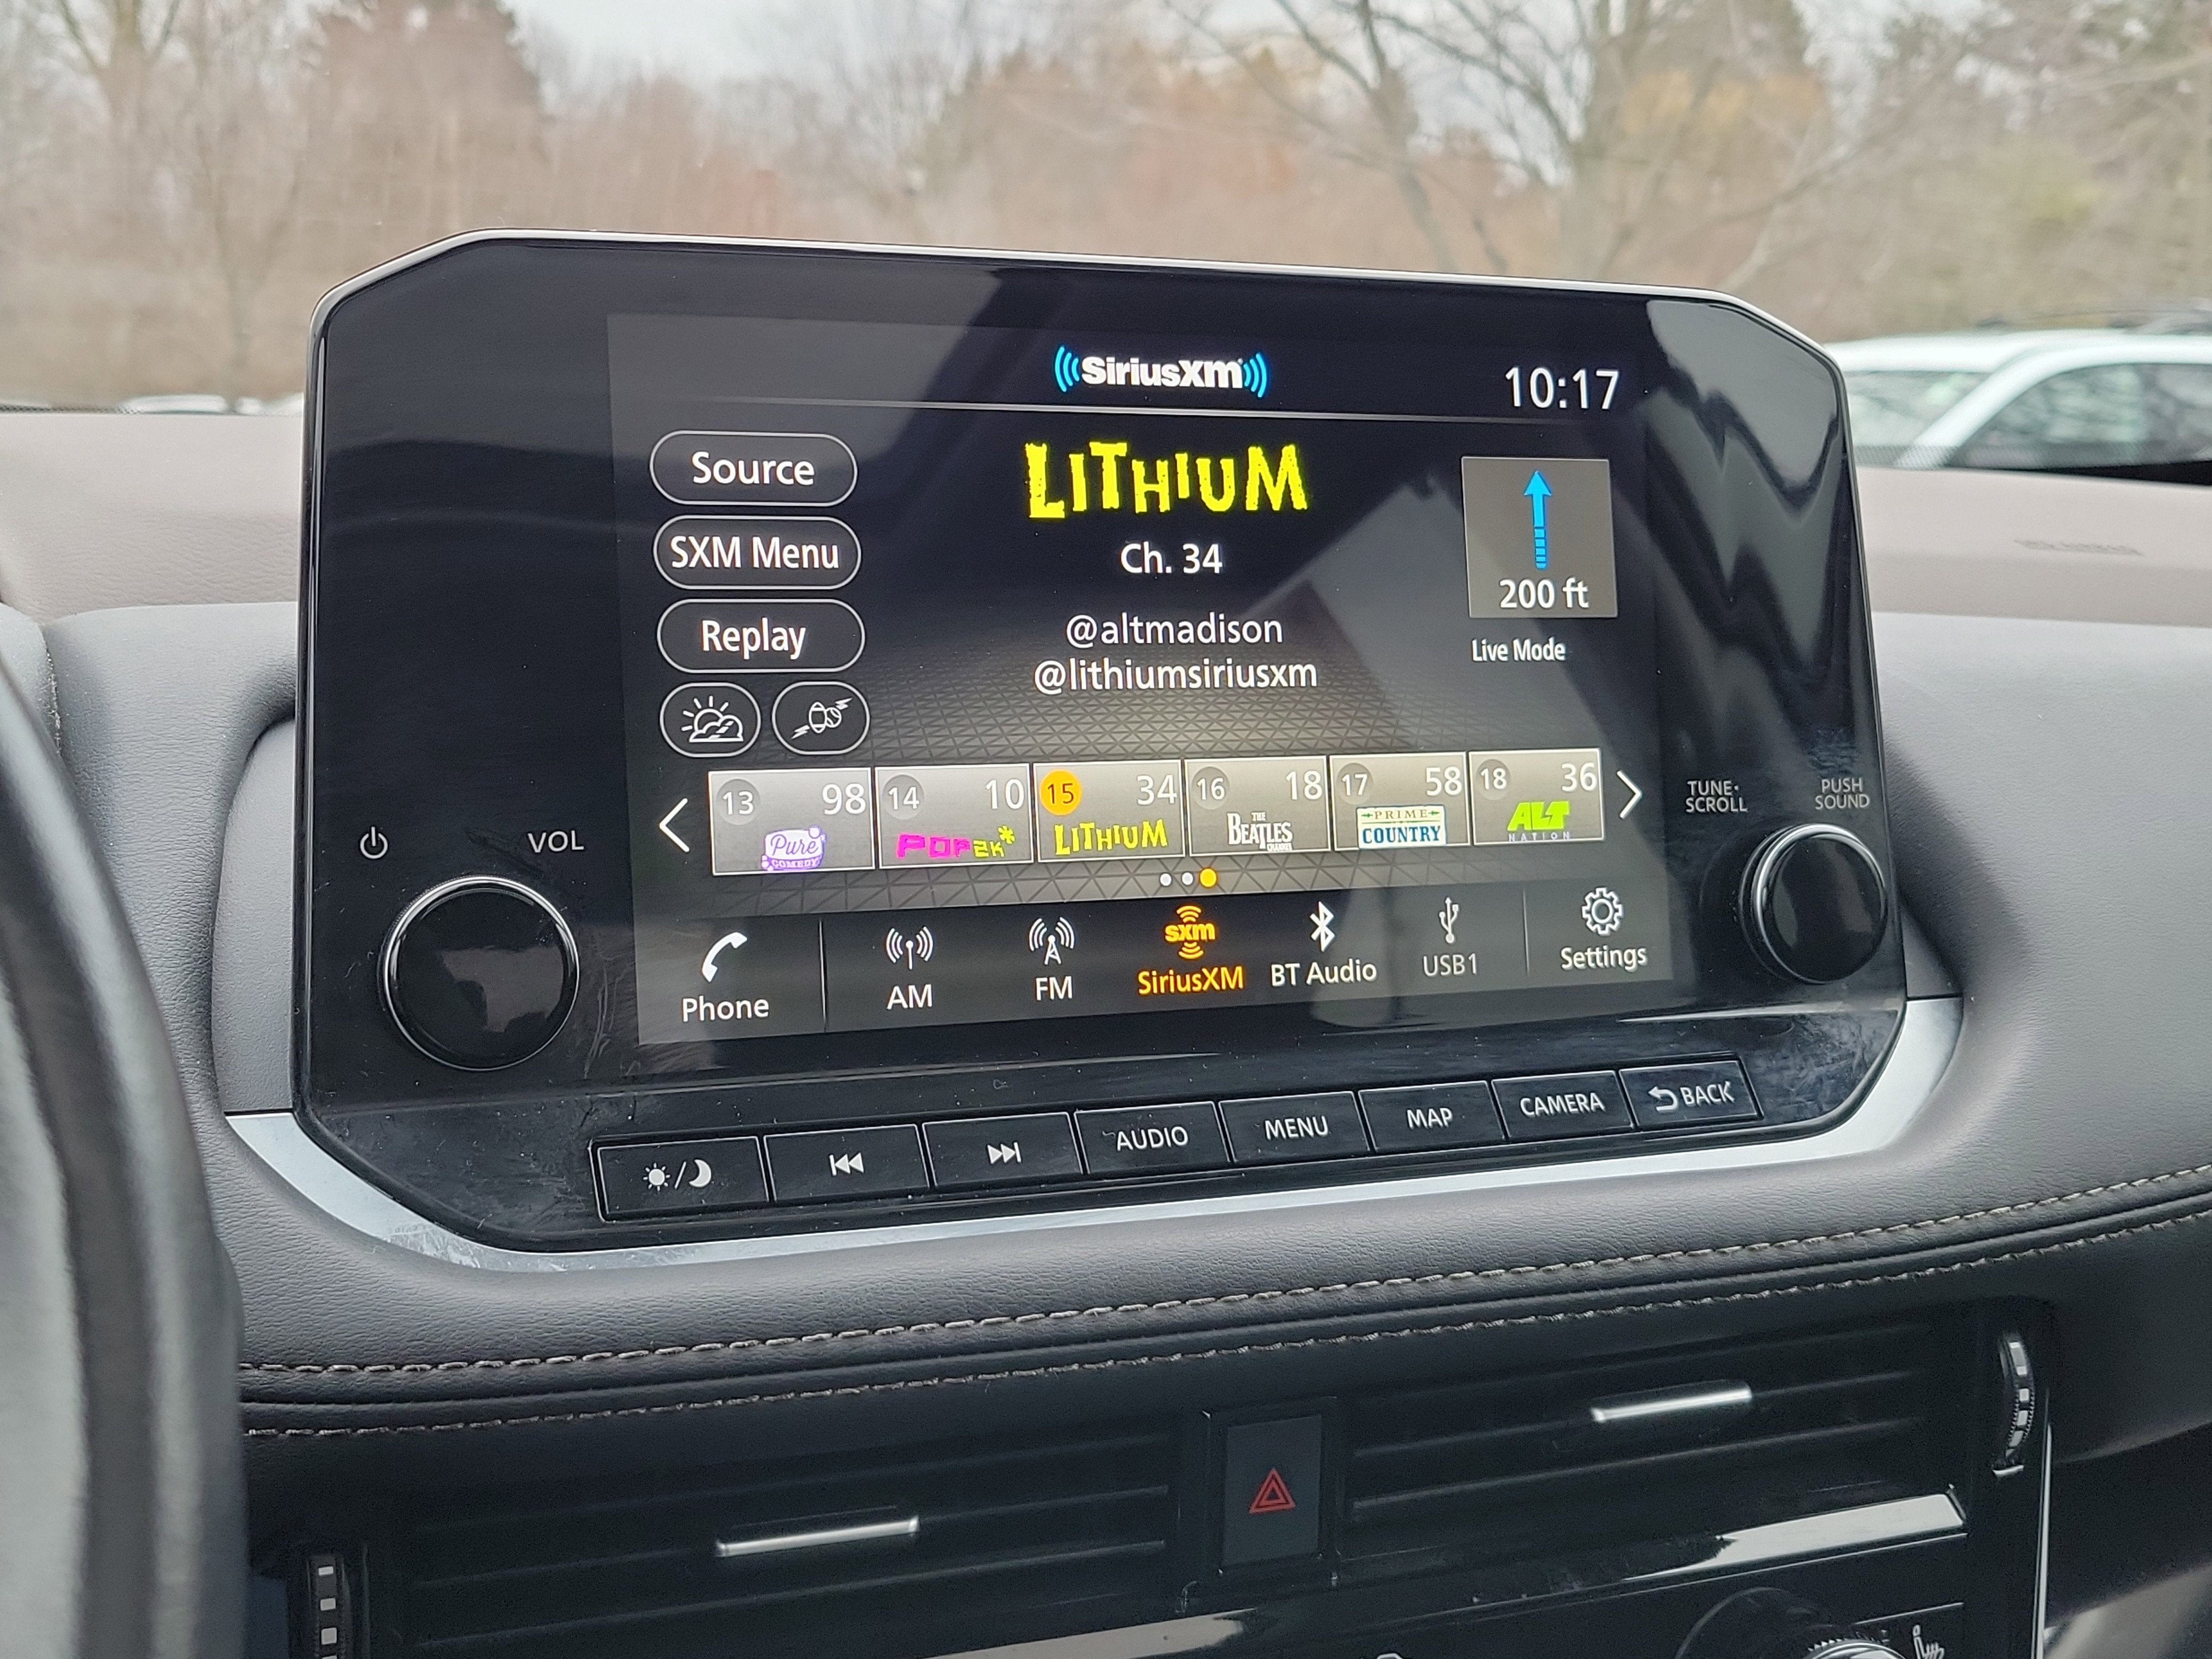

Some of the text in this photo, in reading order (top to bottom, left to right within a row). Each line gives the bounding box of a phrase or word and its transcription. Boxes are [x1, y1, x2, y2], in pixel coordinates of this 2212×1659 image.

[1505, 366, 1620, 410] 10:17
[692, 451, 815, 486] Source
[670, 535, 839, 568] SXM Menu
[1120, 541, 1223, 573] Ch. 34
[1499, 577, 1589, 609] 200 ft
[702, 617, 806, 659] Replay
[1066, 611, 1283, 648] @altmadison
[1471, 637, 1566, 661] Live Mode
[1034, 658, 1318, 694] @lithiumsiriusxm
[1196, 776, 1226, 801] 16
[1285, 770, 1323, 800] 18
[1341, 774, 1368, 797] 17
[1425, 766, 1463, 797] 58
[1480, 767, 1508, 790] 18
[1560, 761, 1598, 792] 36
[1820, 777, 1864, 793] PUSH
[722, 790, 754, 816] 13
[822, 783, 867, 815] 98
[887, 786, 920, 810] 14
[985, 778, 1025, 810] 10
[1046, 781, 1075, 805] 15
[1136, 774, 1178, 806] 34
[1815, 794, 1870, 811] SOUND
[1374, 808, 1428, 820] PRIME
[1506, 800, 1571, 832] ALT
[1685, 797, 1748, 813] SCROLL
[527, 830, 585, 854] VOL
[770, 833, 820, 856] Pure
[1362, 825, 1442, 845] COUNTRY
[1508, 830, 1572, 843] NATION
[1423, 953, 1478, 977] USB1
[1560, 945, 1647, 971] Settings
[1137, 966, 1244, 995] SiriusXM
[1271, 958, 1378, 987] BT Audio
[886, 984, 933, 1010] AM
[1035, 976, 1074, 1001] FM
[681, 996, 769, 1023] Phone
[1520, 1092, 1605, 1117] CAMERA
[1680, 1081, 1735, 1107] BACK
[1265, 1116, 1329, 1141] MENU
[1406, 1107, 1453, 1130] MAP
[1116, 1126, 1189, 1152] AUDIO
